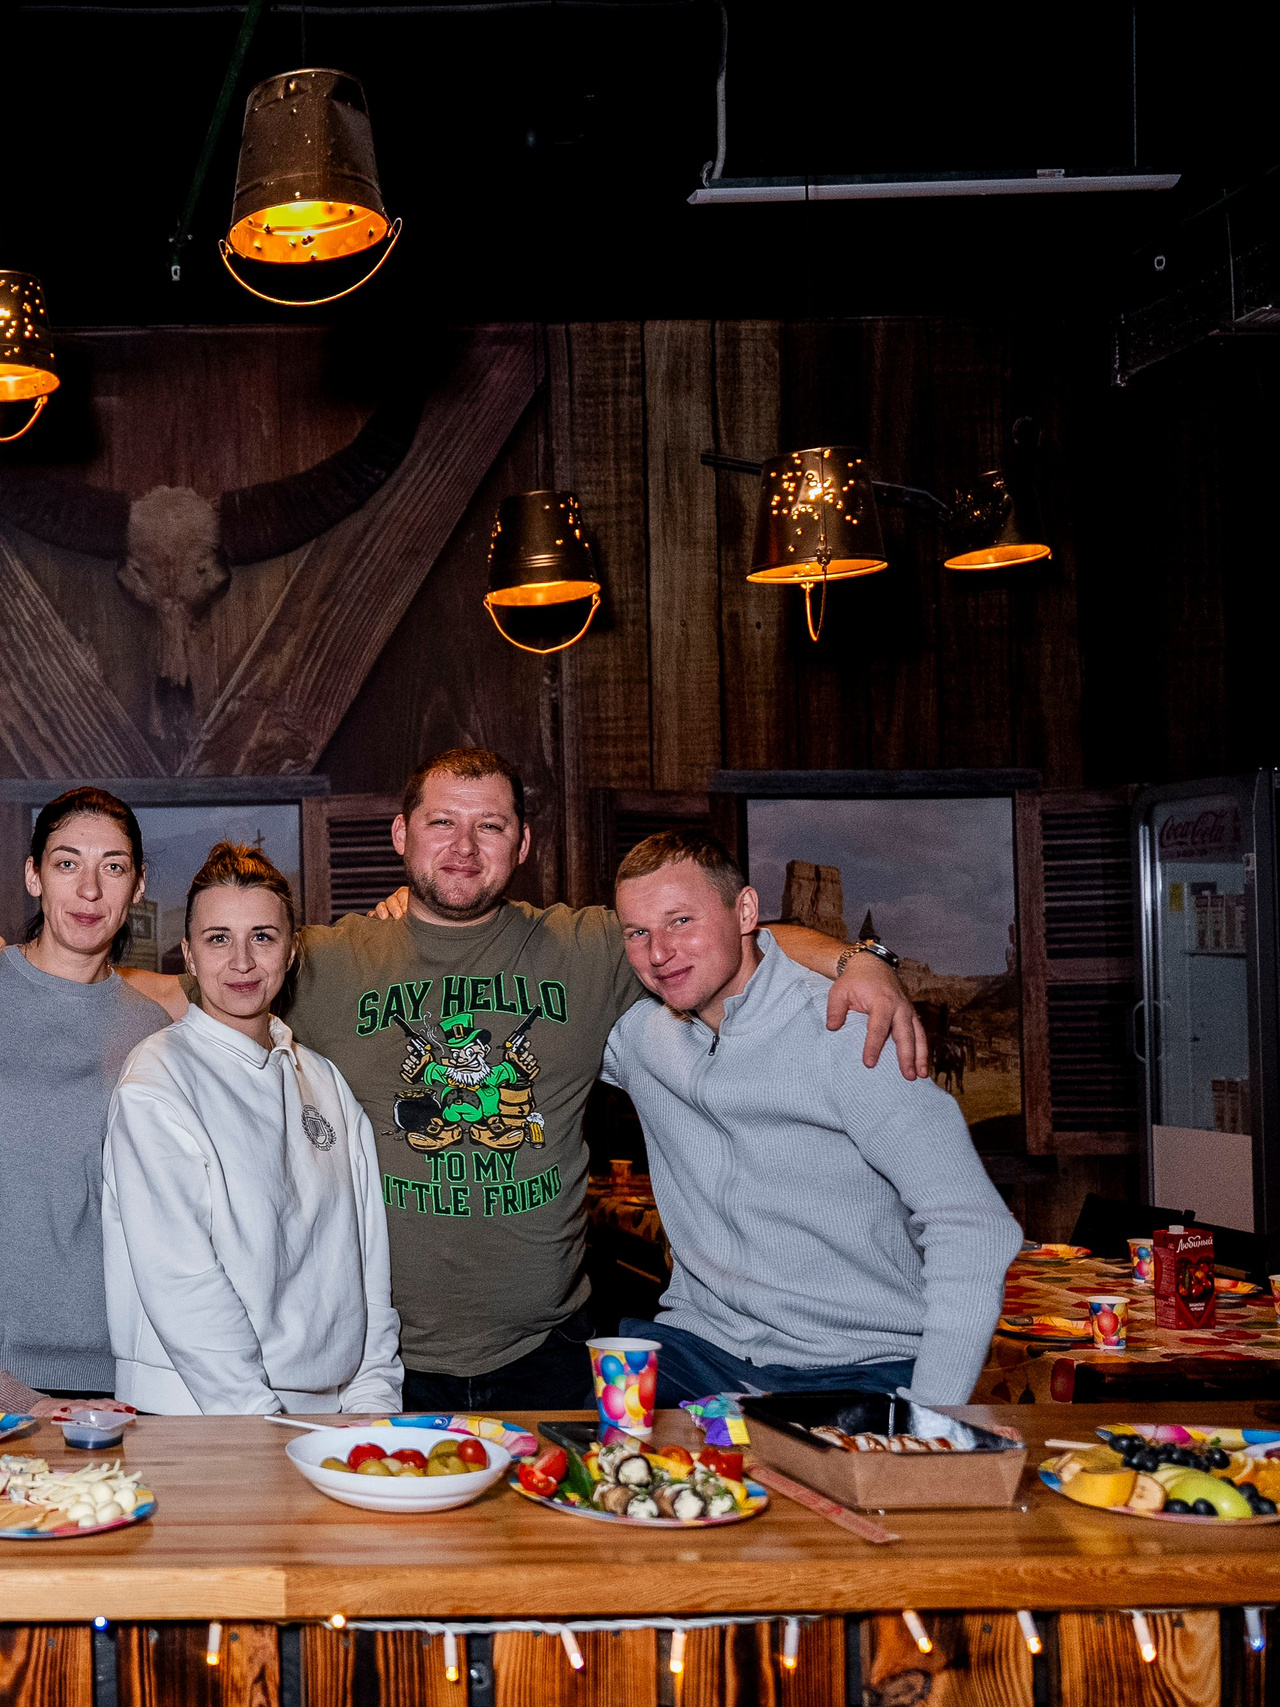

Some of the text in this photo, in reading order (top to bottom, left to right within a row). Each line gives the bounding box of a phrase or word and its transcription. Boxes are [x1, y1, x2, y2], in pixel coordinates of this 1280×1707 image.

[356, 971, 568, 1036] SAY HELLO
[426, 1151, 517, 1183] TO MY
[382, 1164, 562, 1217] ITTLE FRIEND
[1176, 1235, 1214, 1253] Любимый
